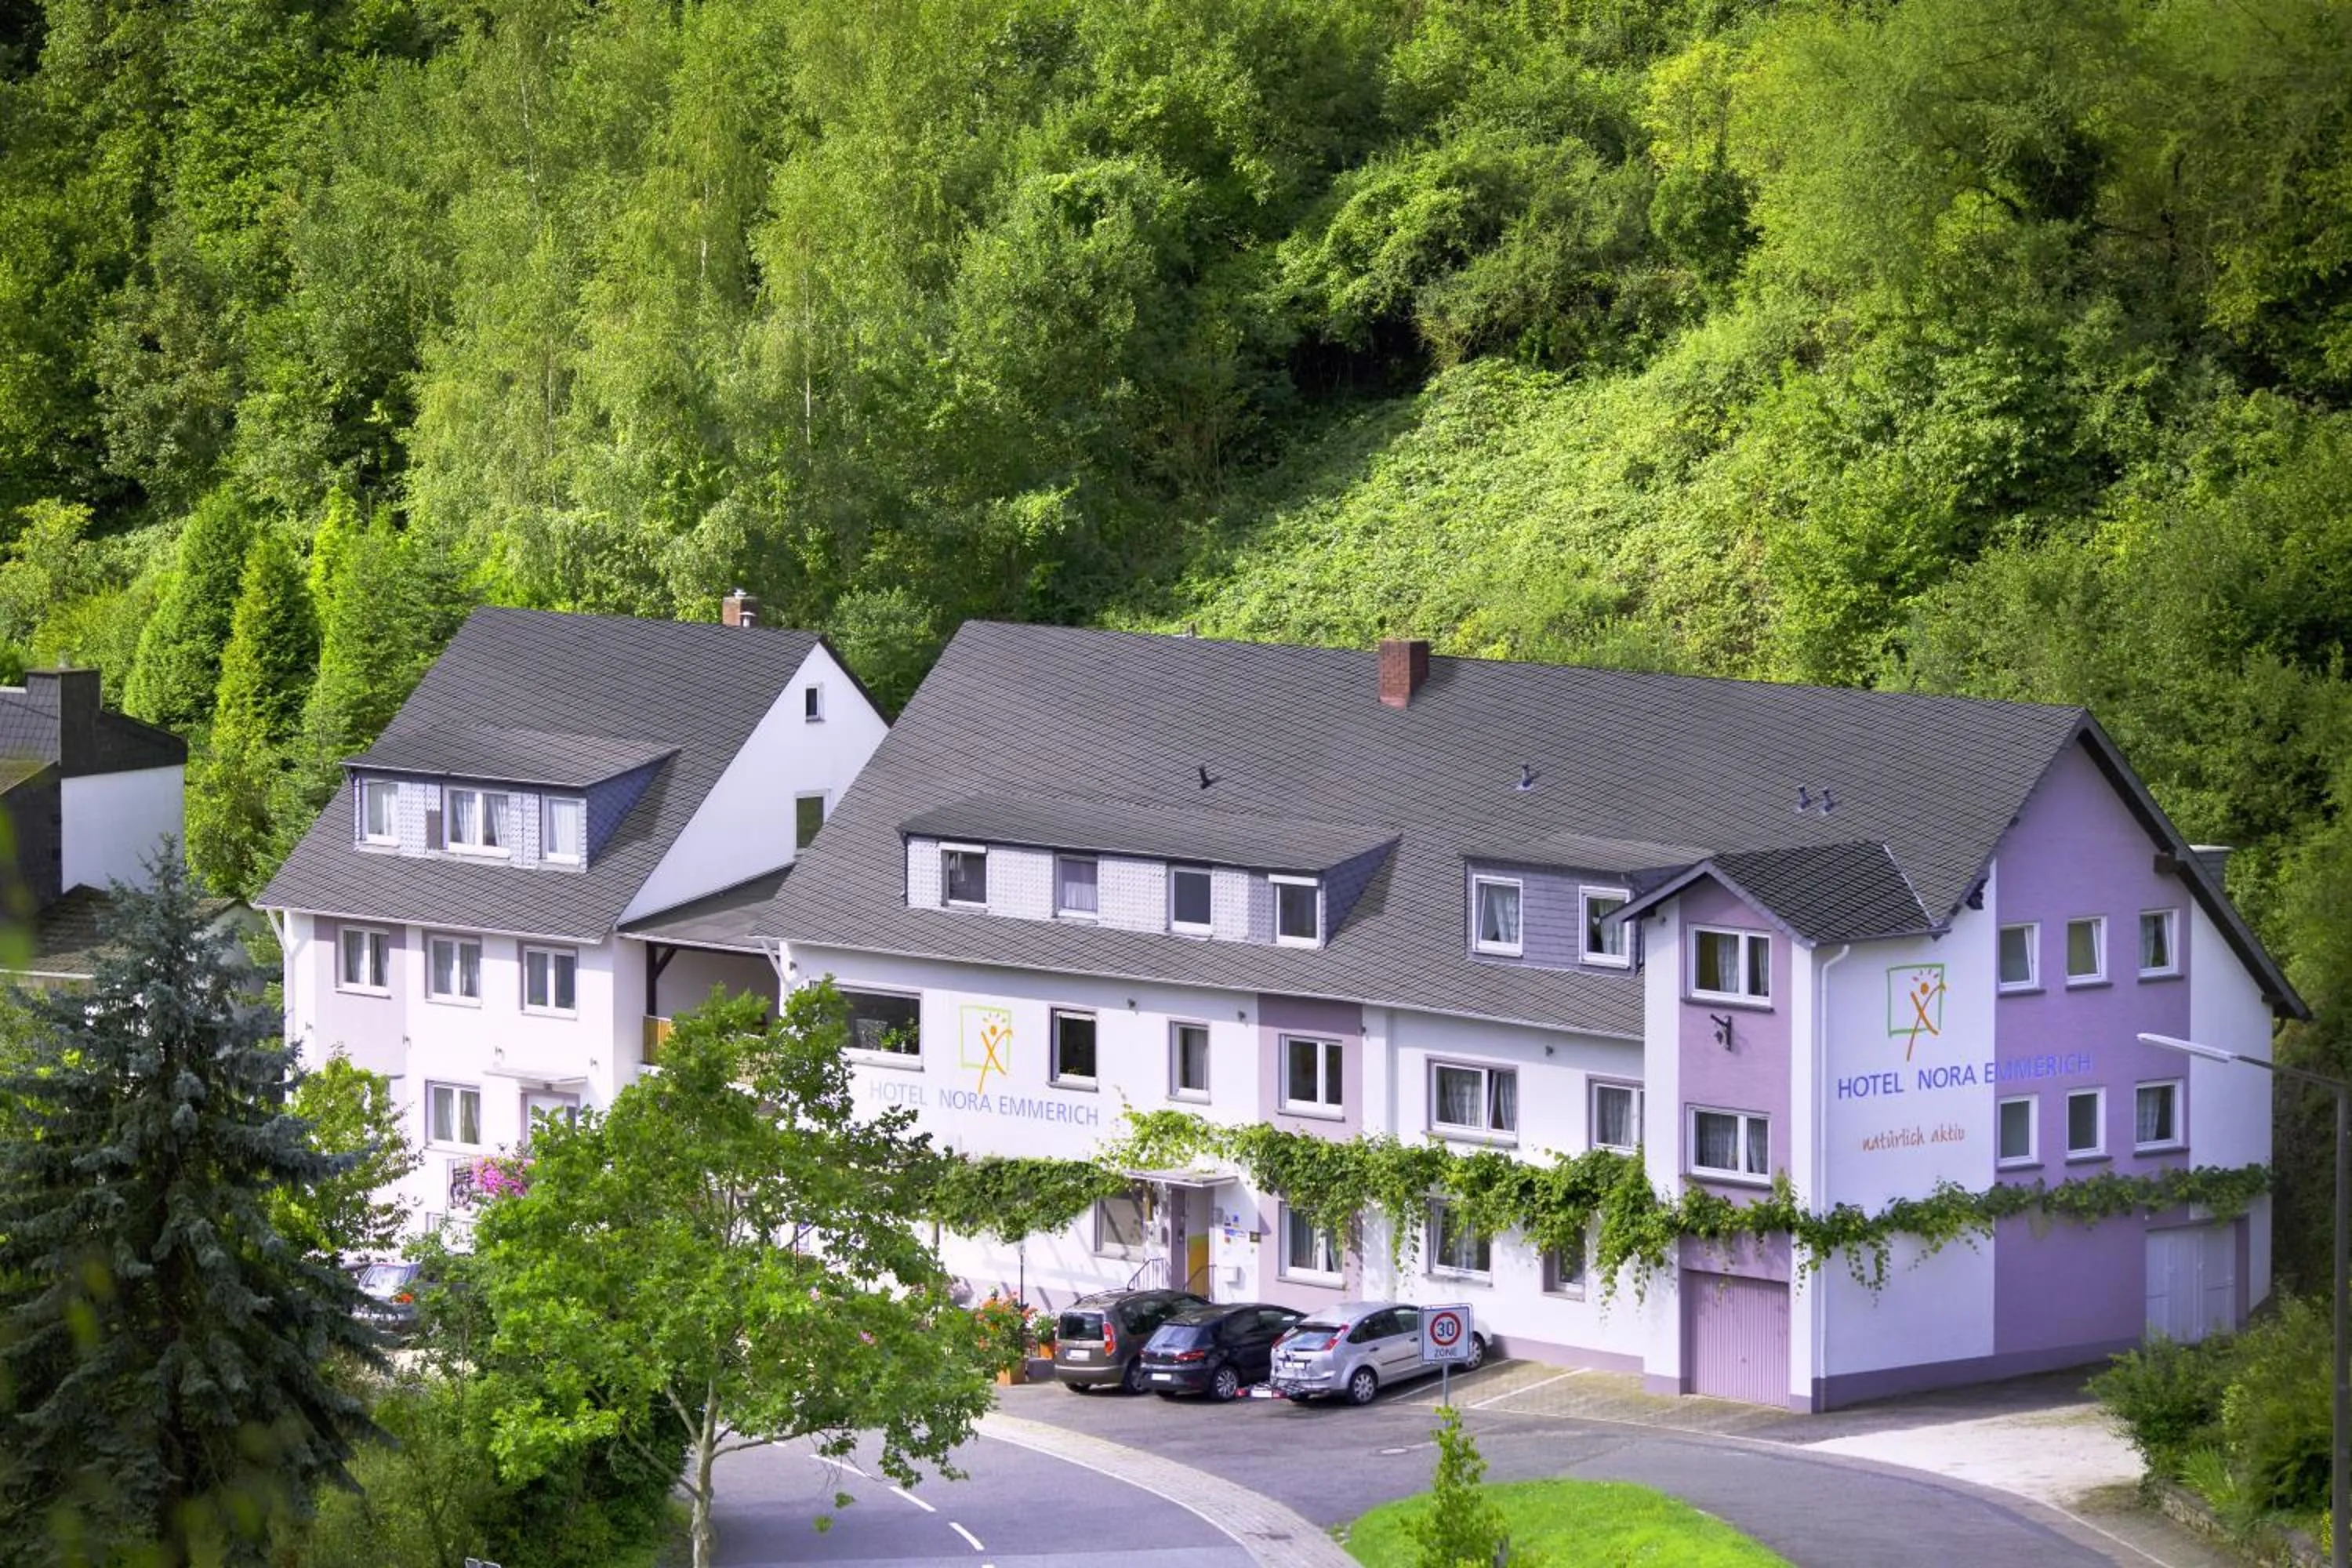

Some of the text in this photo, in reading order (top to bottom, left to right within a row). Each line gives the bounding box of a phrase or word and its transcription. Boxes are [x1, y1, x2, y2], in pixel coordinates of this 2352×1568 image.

[1838, 1053, 2092, 1099] HOTEL NORA EMMERICH
[869, 1080, 1098, 1126] HOTEL NORA EMMERICH
[1863, 1123, 1965, 1152] natürlich aktiv
[1436, 1321, 1455, 1338] 30
